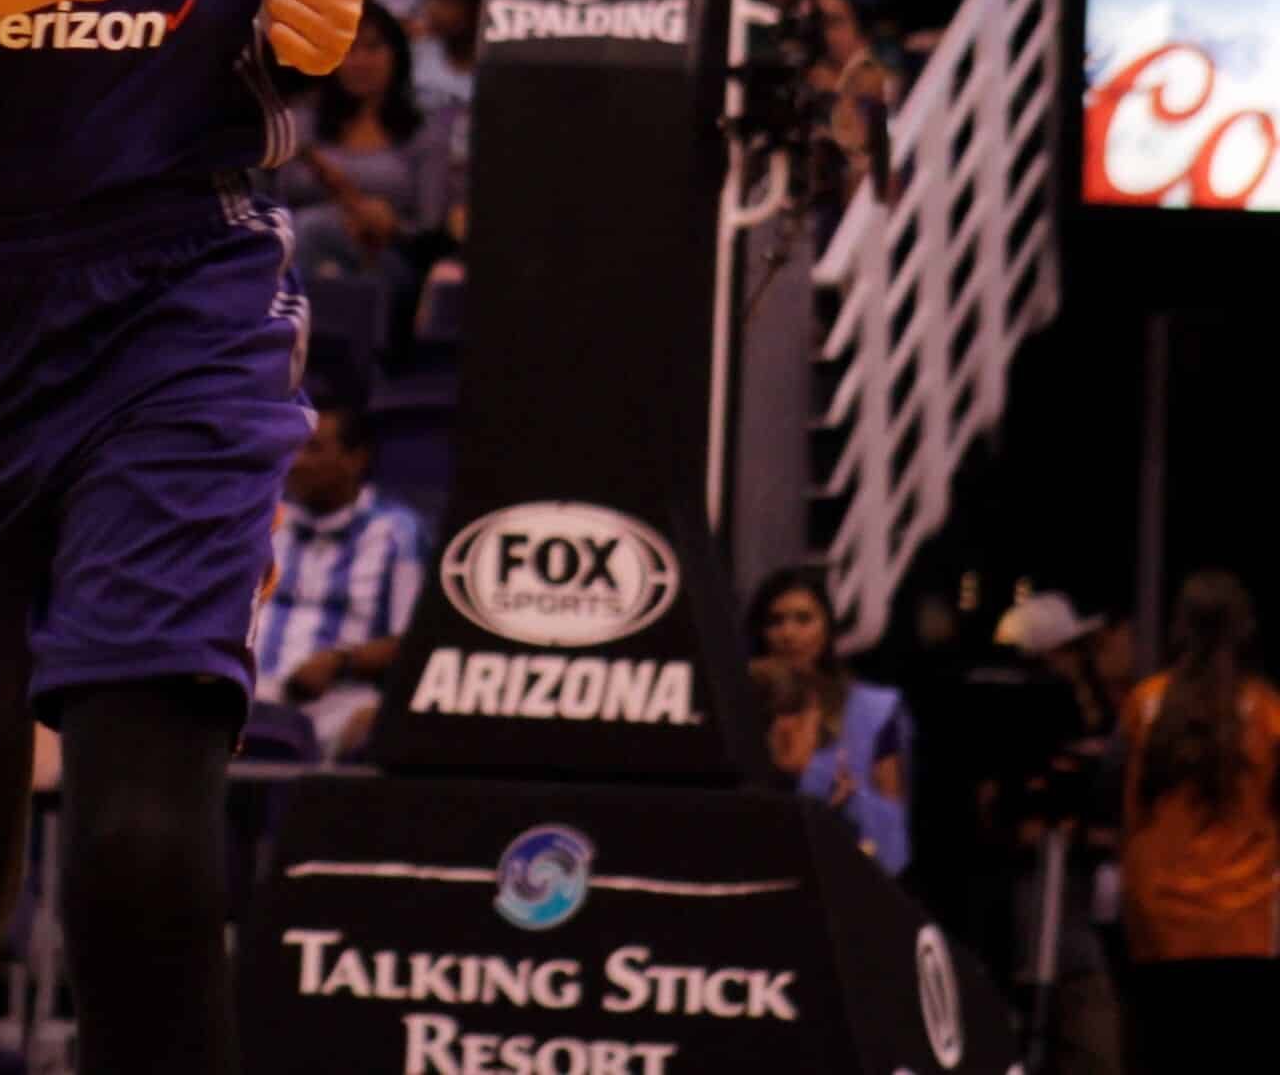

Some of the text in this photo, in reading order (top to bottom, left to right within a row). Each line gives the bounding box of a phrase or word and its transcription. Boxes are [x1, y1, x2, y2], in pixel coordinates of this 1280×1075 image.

[496, 533, 620, 589] FOX
[492, 591, 626, 616] SPORTS
[410, 648, 694, 725] ARIZONA
[282, 929, 797, 1020] TALKING STICK
[402, 1013, 678, 1075] RESORT
